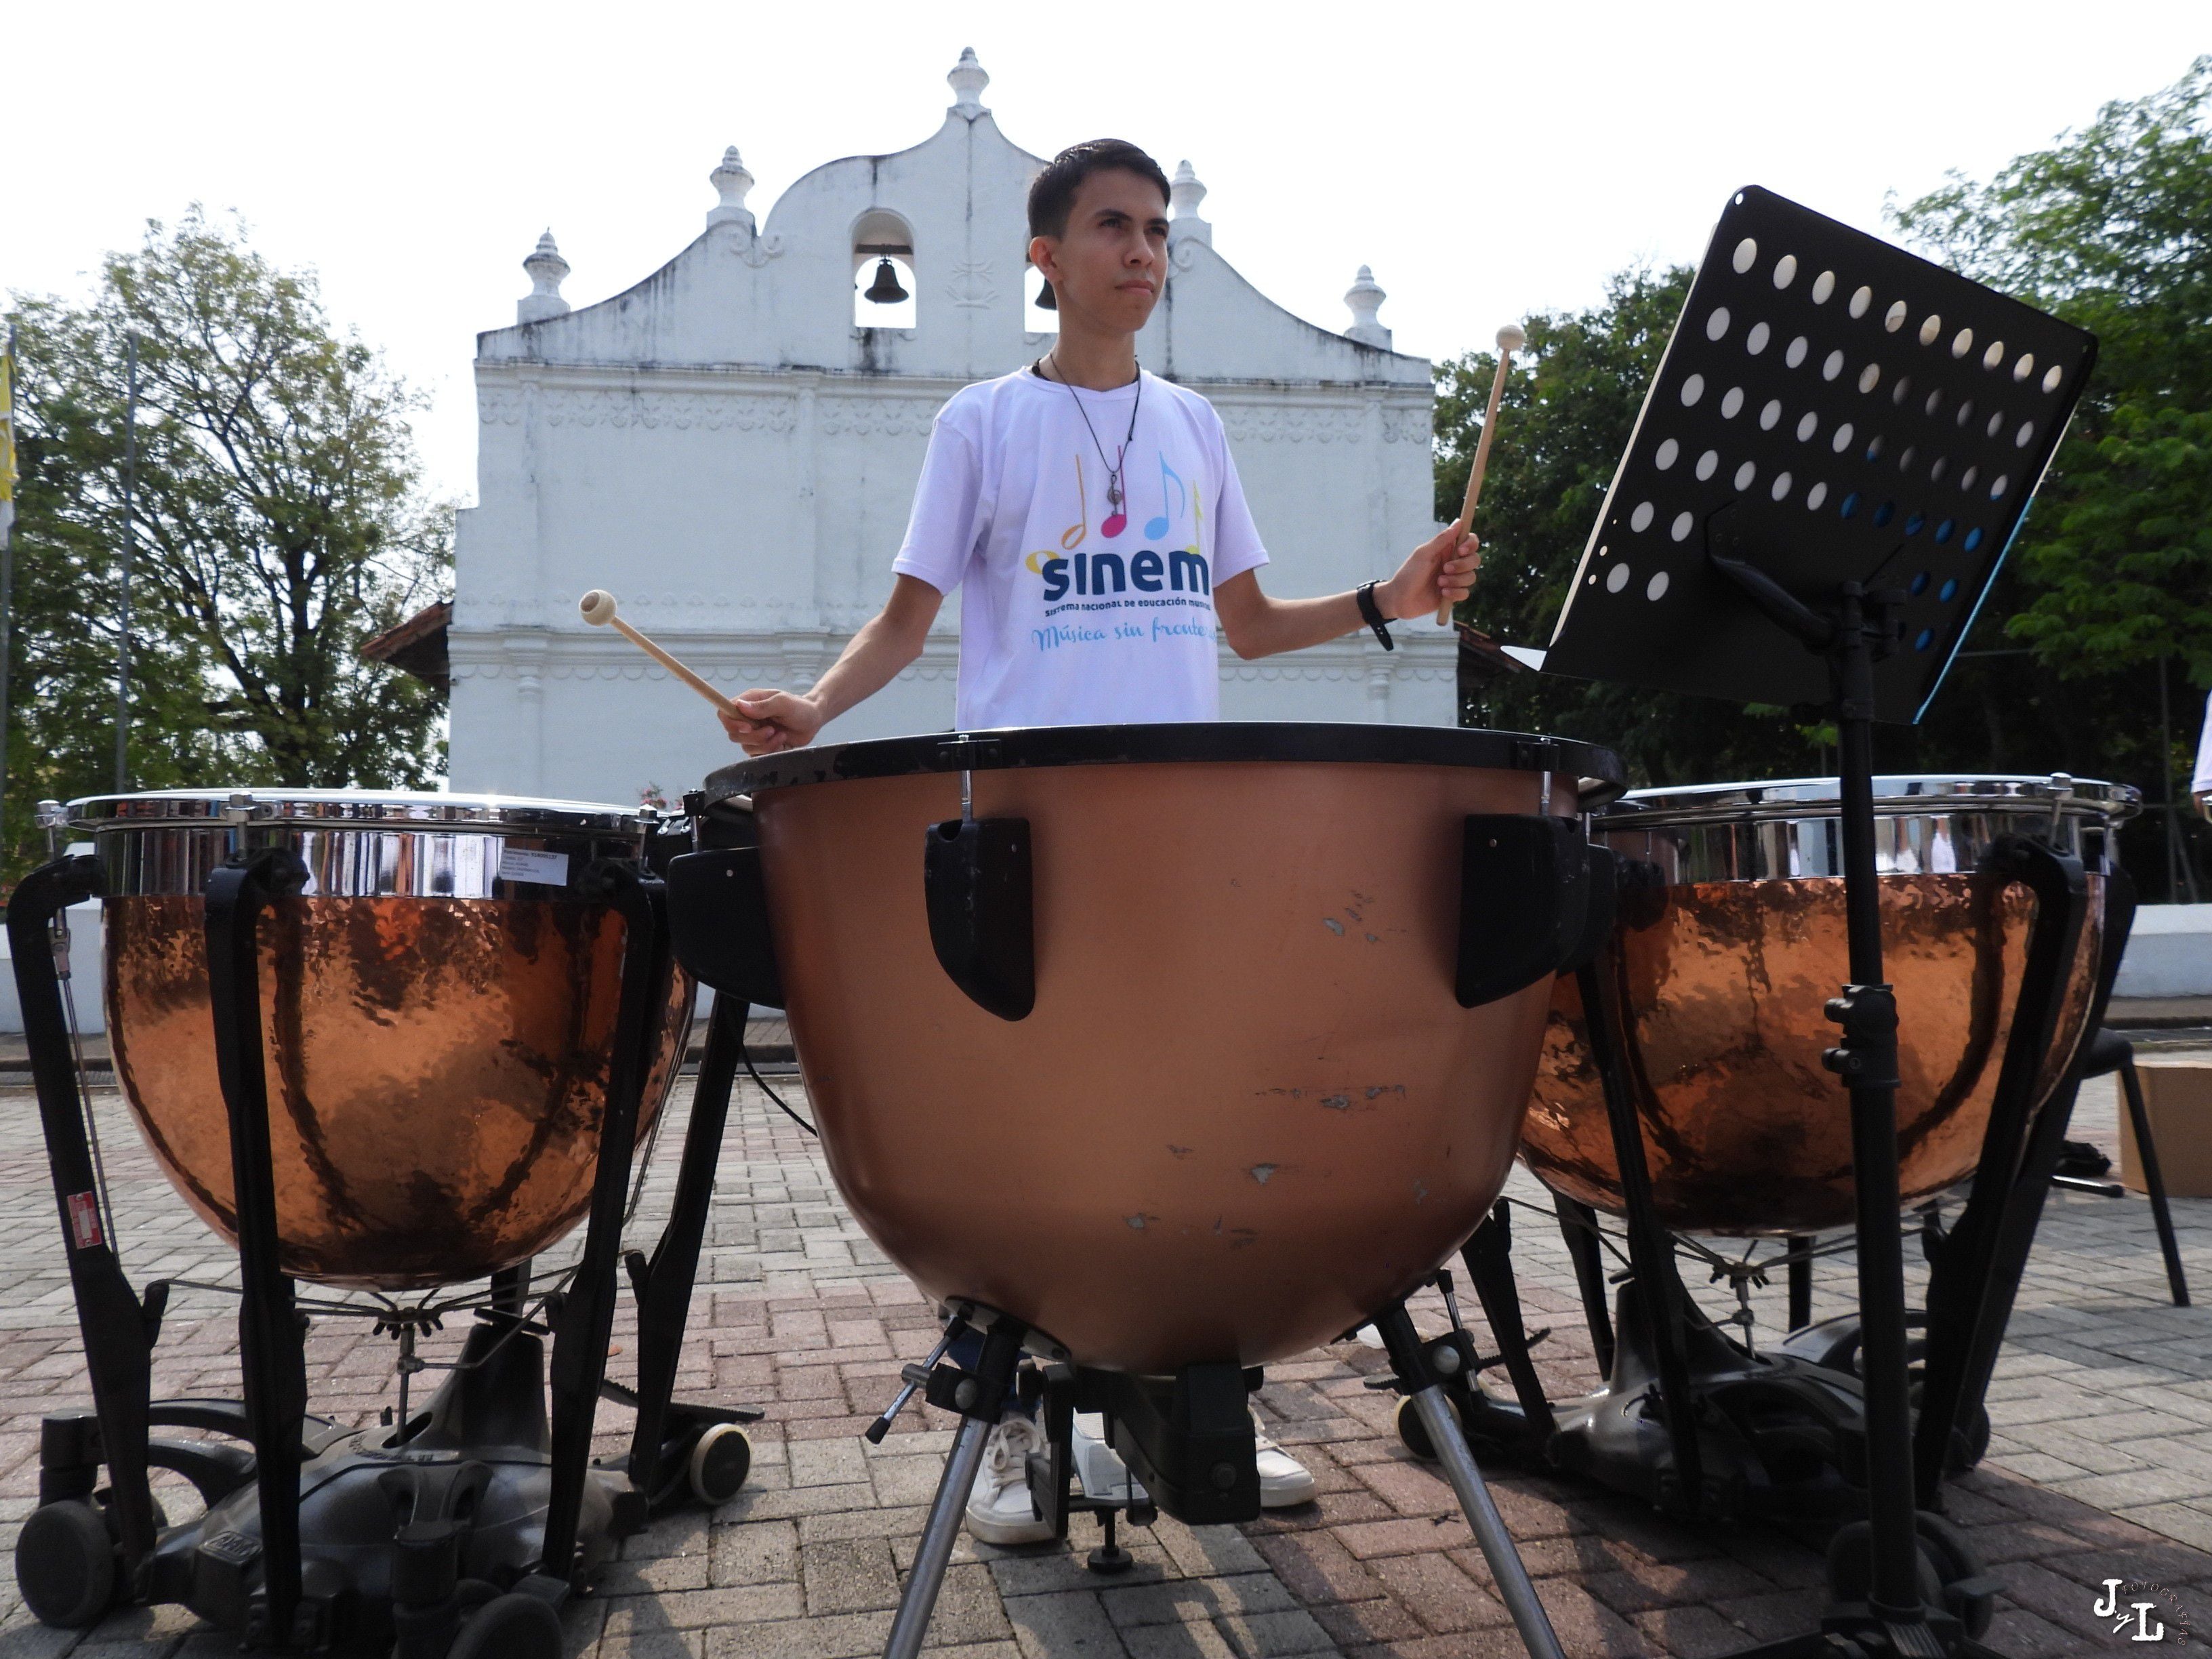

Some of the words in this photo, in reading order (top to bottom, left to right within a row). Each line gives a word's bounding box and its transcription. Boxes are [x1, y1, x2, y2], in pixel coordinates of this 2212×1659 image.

[1042, 550, 1210, 601] sinem
[1031, 624, 1107, 652] Música
[1115, 621, 1145, 640] sin
